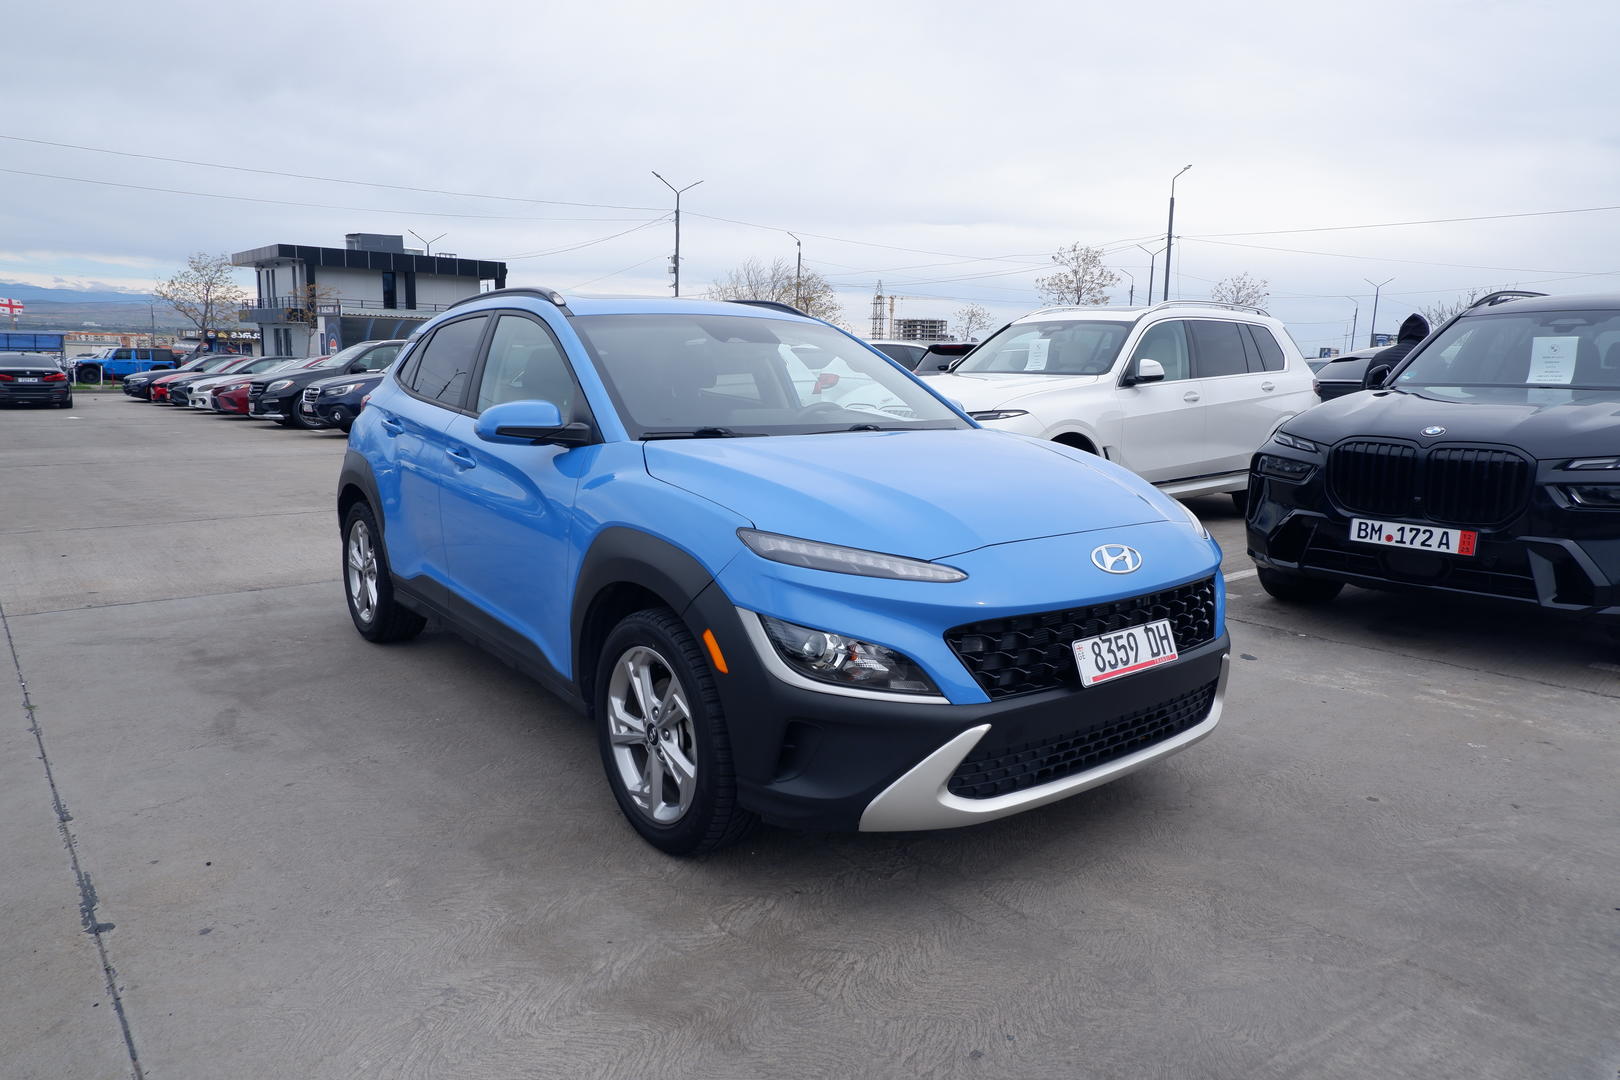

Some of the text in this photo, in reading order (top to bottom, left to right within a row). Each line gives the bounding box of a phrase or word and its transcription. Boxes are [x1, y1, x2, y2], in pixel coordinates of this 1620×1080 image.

[1356, 521, 1450, 550] BM 172 A
[1091, 624, 1173, 672] 8359 DH
